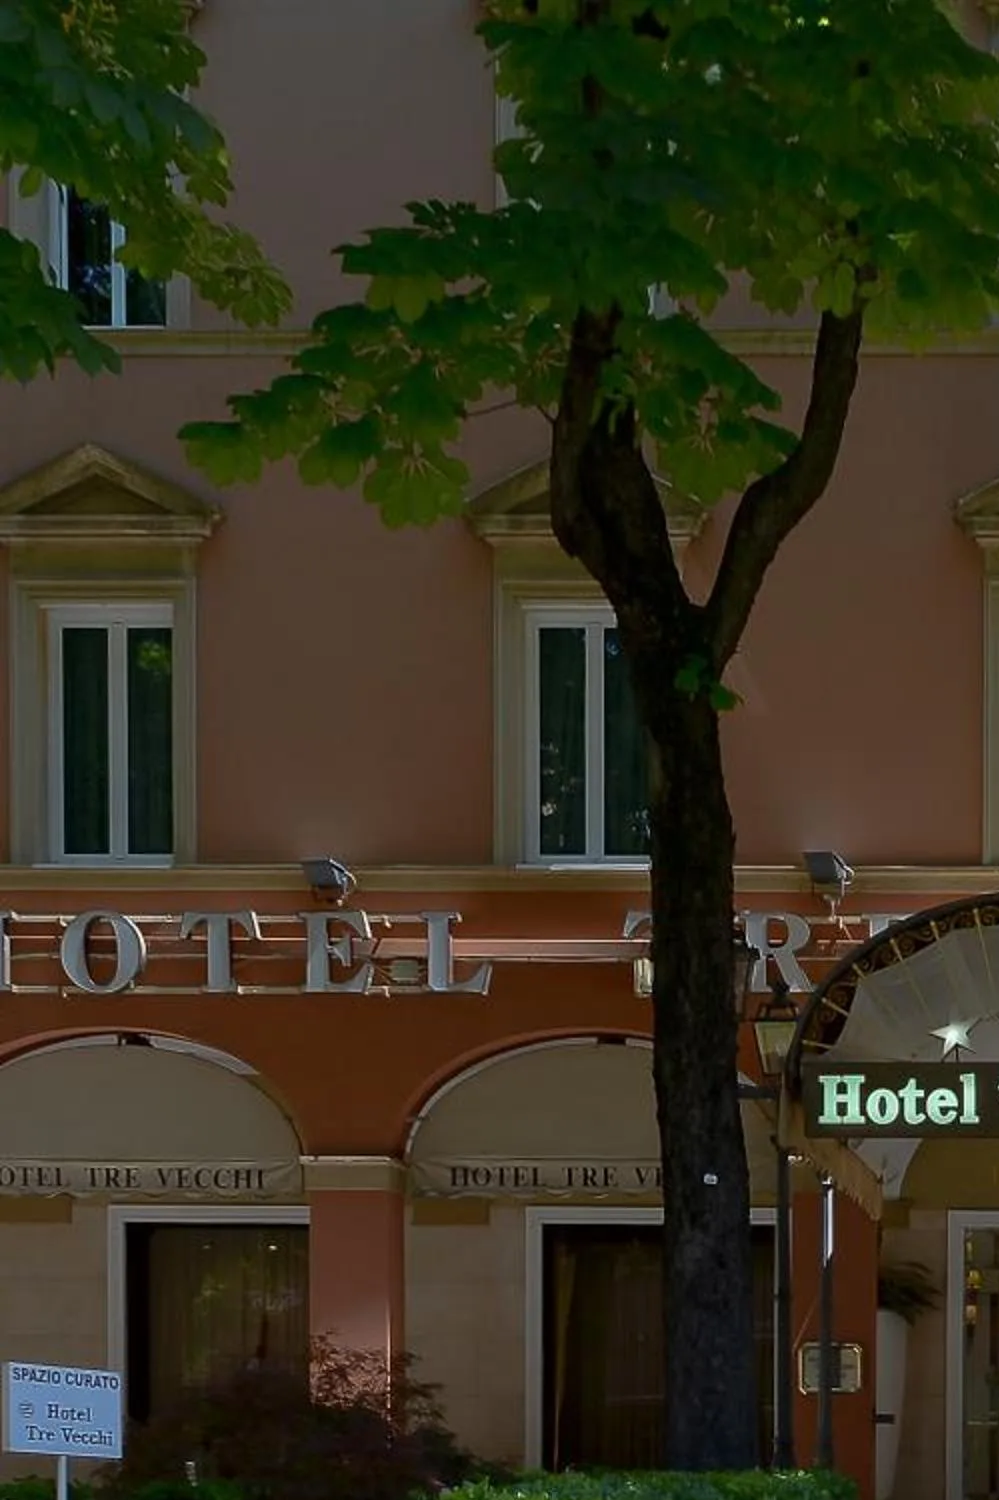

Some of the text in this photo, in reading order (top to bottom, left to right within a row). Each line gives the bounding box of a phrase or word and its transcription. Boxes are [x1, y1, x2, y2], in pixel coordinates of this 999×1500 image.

[817, 1073, 980, 1125] Hotel
[0, 1166, 266, 1190] OTEL TRE VECCHI
[450, 1166, 548, 1187] HOTEL
[562, 1166, 619, 1188] TRE
[12, 1367, 119, 1390] SPAZIO CURATO
[47, 1403, 93, 1422] Hotel
[26, 1425, 113, 1446] Tre Vecchi
